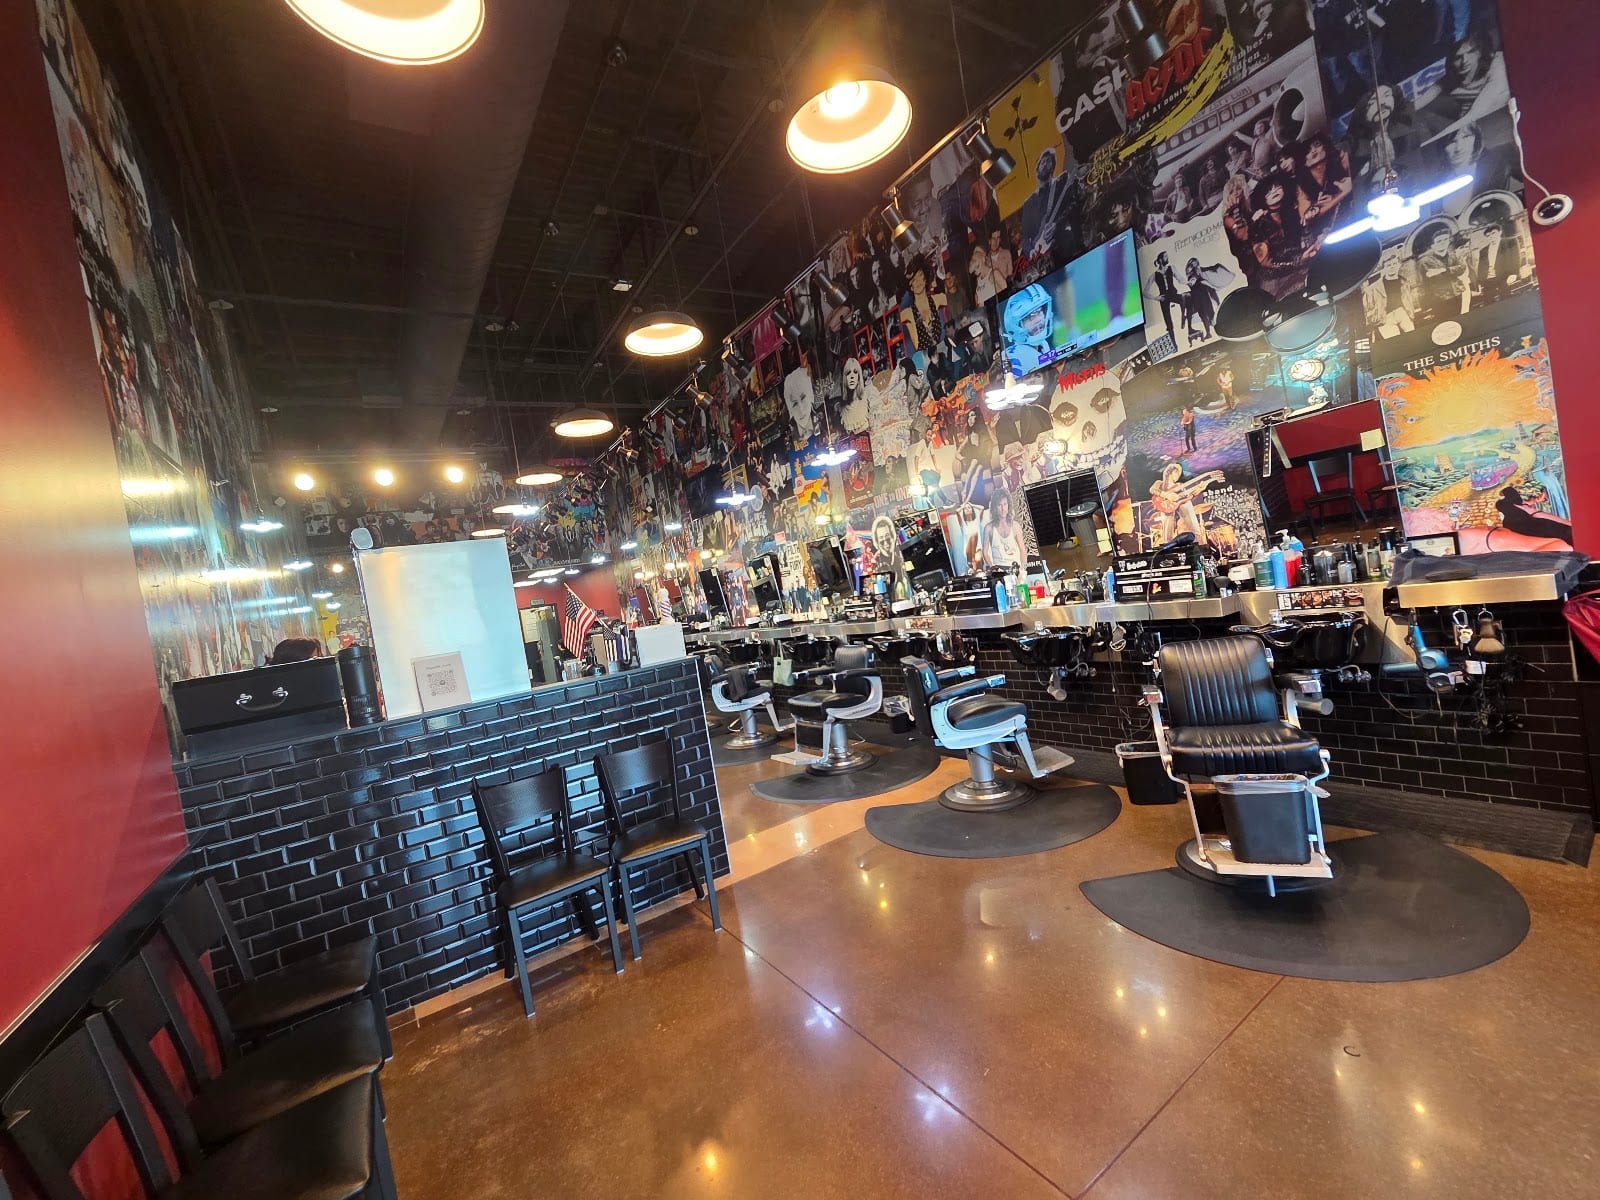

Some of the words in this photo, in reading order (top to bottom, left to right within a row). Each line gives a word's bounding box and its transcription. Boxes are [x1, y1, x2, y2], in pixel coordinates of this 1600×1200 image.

[1403, 355, 1435, 372] THE
[1439, 336, 1501, 362] SMITHS
[1058, 362, 1106, 394] MISFITS
